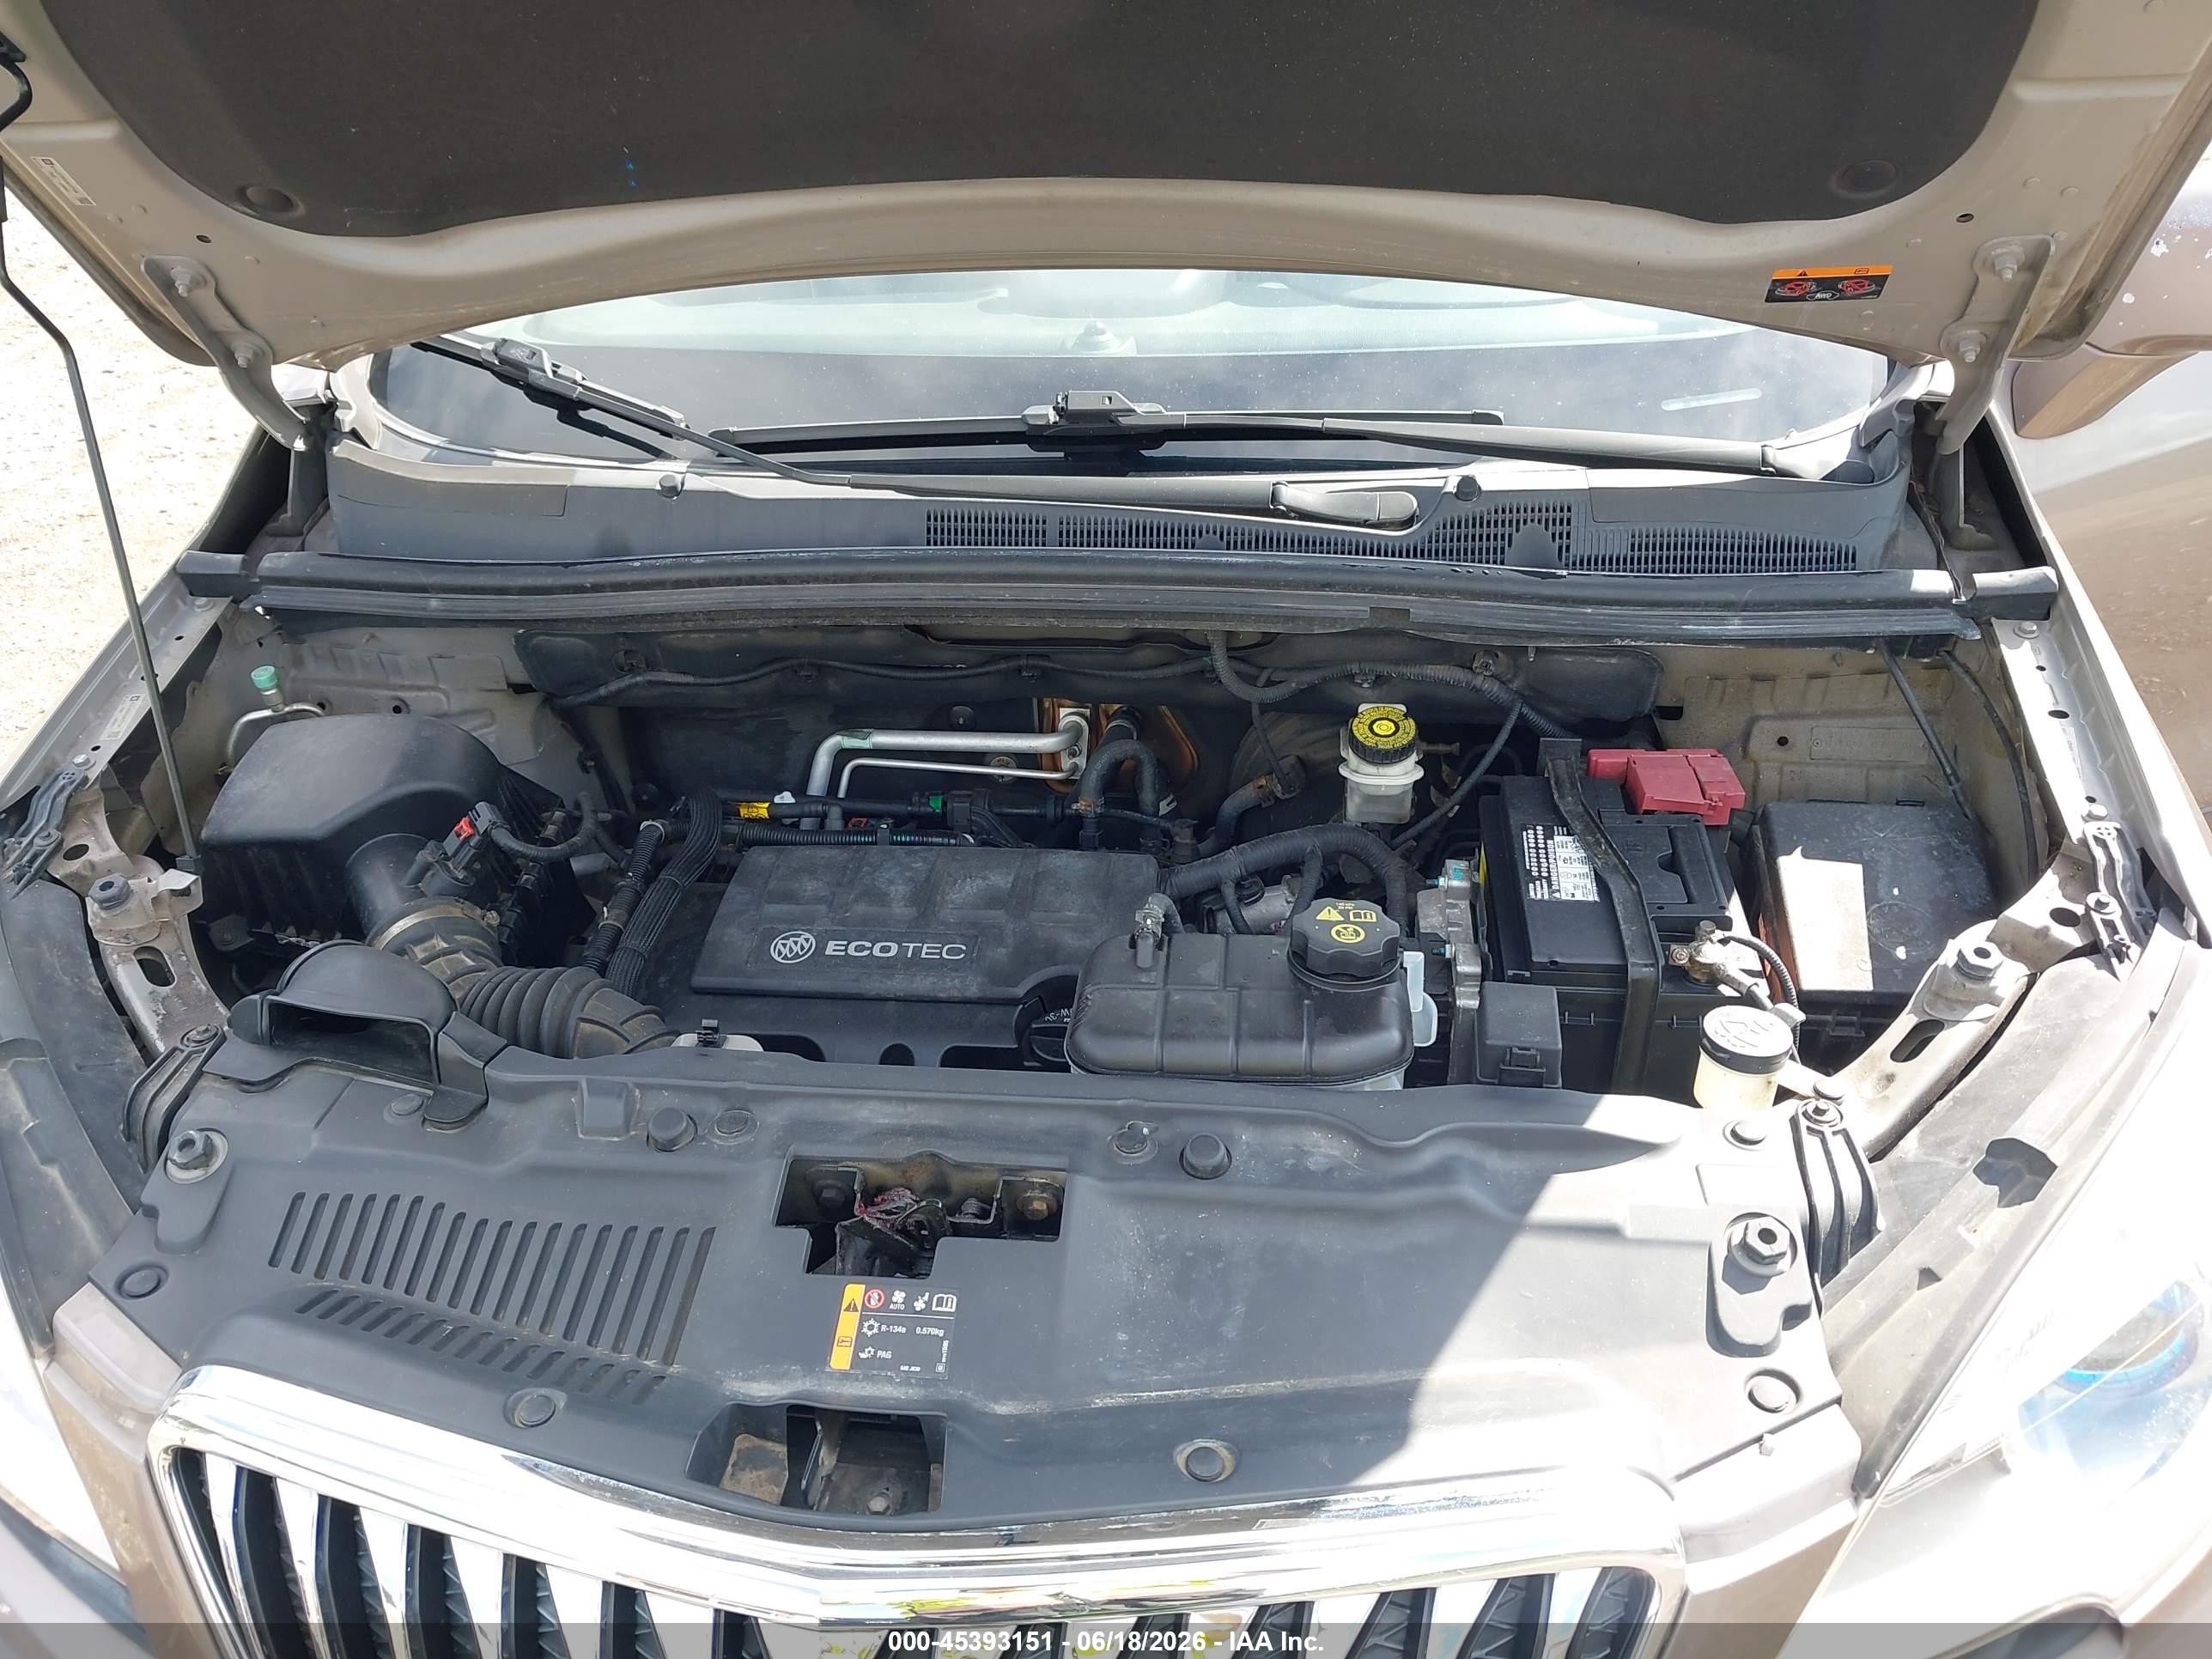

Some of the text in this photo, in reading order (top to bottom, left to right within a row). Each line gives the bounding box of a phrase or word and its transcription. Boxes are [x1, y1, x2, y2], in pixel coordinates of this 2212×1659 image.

[1547, 839, 1560, 890] DANGER/POISON
[824, 940, 967, 960] ECOTEC
[880, 1325, 945, 1337] R-134a 0.570kg
[877, 1350, 892, 1359] PAG
